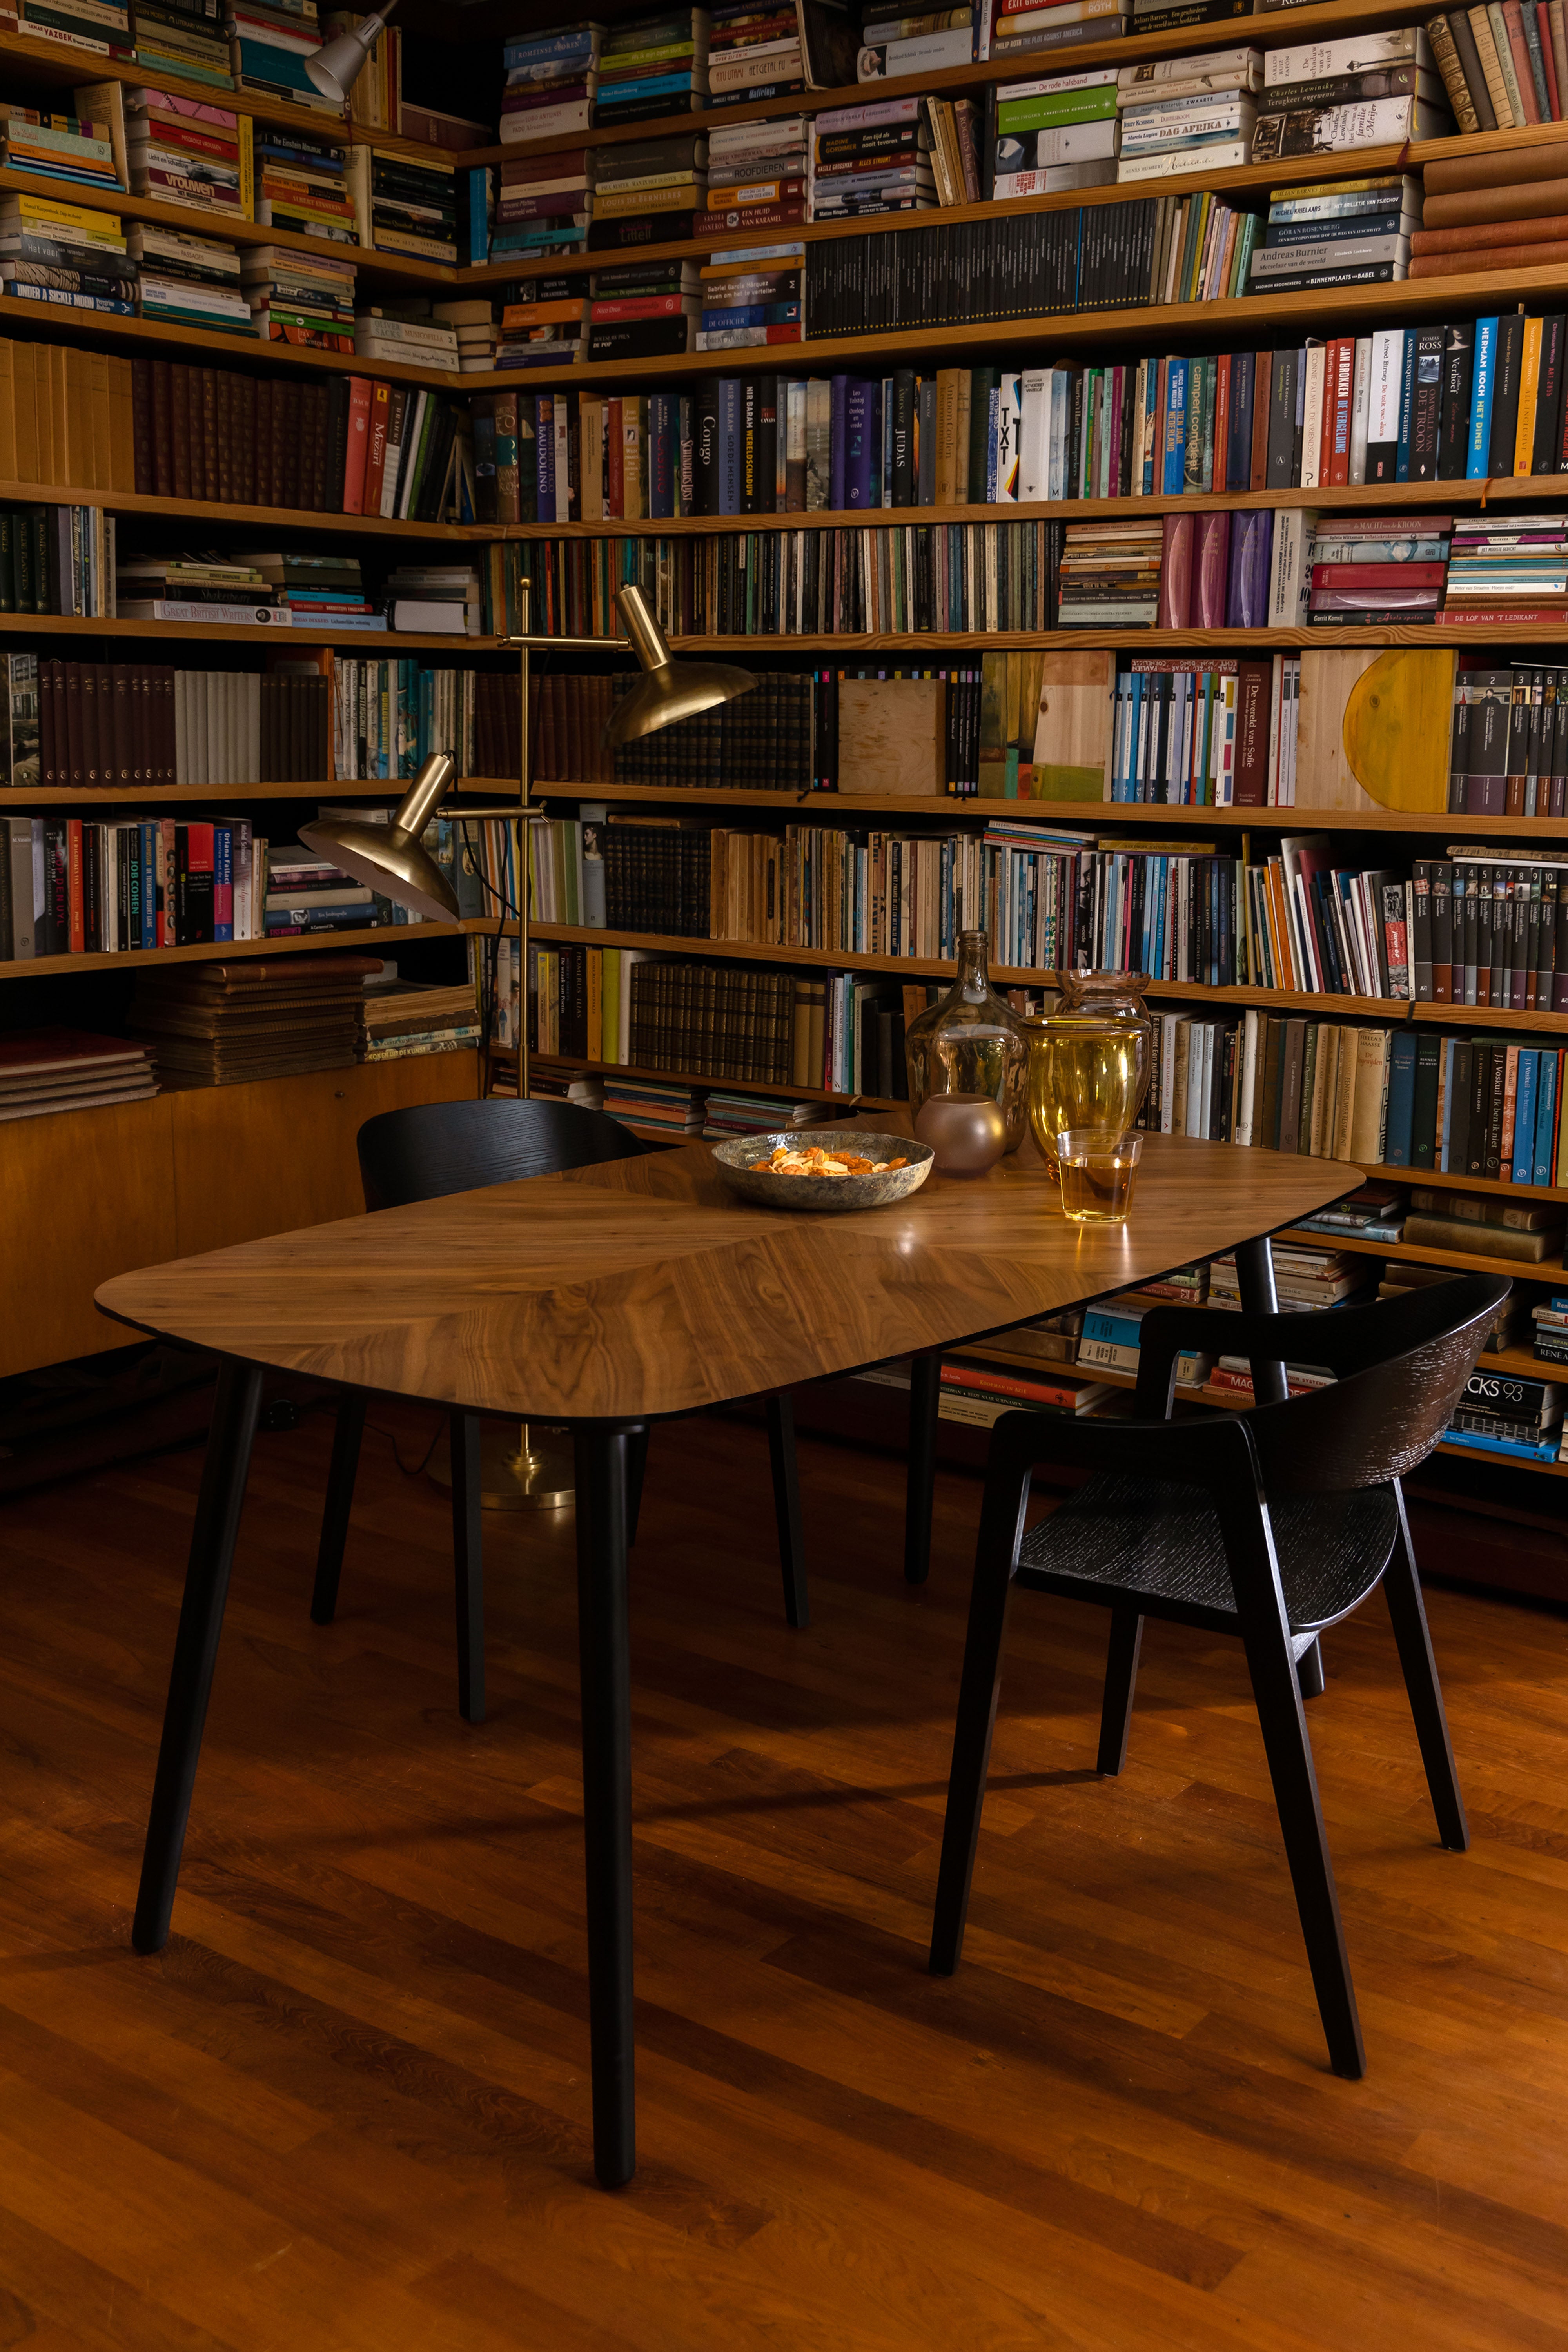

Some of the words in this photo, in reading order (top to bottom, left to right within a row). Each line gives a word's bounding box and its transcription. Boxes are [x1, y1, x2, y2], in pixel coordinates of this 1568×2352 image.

[44, 29, 72, 42] YAZBEK
[995, 41, 1009, 50] PHILIP
[1011, 40, 1022, 48] ROTH
[1032, 37, 1042, 45] PLOT
[1044, 33, 1062, 42] AGAINST
[1063, 27, 1083, 38] AMERICA
[1049, 81, 1061, 89] rode
[1062, 77, 1087, 87] halsband
[1299, 84, 1334, 94] Lewinsky
[1267, 97, 1301, 107] Terugkeer
[1302, 91, 1335, 102] ongewenst
[1357, 107, 1365, 137] familie
[1368, 104, 1377, 137] Meijer
[1159, 129, 1180, 138] DAG
[1181, 121, 1221, 134] AFRIKA
[282, 138, 301, 149] Einstein
[302, 142, 321, 154] Almanac
[826, 144, 857, 153] GORDIMER
[877, 138, 897, 146] tevoren
[148, 153, 158, 162] Licht
[168, 158, 189, 170] schaduw
[735, 163, 784, 178] ROOFDIEREN
[166, 174, 215, 196] vrouwen
[602, 198, 624, 207] LOUIS
[639, 191, 681, 203] BERNIÈRES
[1294, 205, 1321, 214] KRIELAARS
[1344, 200, 1365, 209] BRILLETJE
[704, 214, 724, 222] SANDRA
[742, 218, 753, 226] VAN
[753, 215, 782, 225] KARAMEL
[699, 222, 724, 232] CISNEROS
[28, 244, 40, 253] Het
[42, 245, 58, 257] veer
[1260, 250, 1294, 261] Andreas
[1296, 247, 1328, 258] Burnier
[1310, 274, 1351, 284] BINNENPLAATS
[17, 284, 40, 297] UNDER
[42, 288, 47, 300] A
[49, 289, 72, 305] SICKLE
[74, 296, 94, 309] MOON
[375, 321, 400, 330] OLIVER
[717, 318, 745, 326] OFFICIER
[375, 328, 400, 338] SACKS
[1419, 341, 1442, 350] ROSS
[1479, 327, 1489, 368] HERMAN
[1339, 347, 1350, 362] JAN
[1338, 363, 1350, 398] BROKKEN
[1450, 357, 1460, 395] Verhoef
[1478, 371, 1488, 397] KOCH
[1191, 366, 1201, 415] campert
[1418, 389, 1428, 405] DE
[1337, 400, 1348, 413] DE
[1476, 400, 1485, 419] HET
[1000, 408, 1009, 465] TXT
[1167, 411, 1176, 452] NEDERLAND
[1335, 413, 1347, 454] VERGELDING
[1416, 408, 1427, 453] TROON
[1474, 422, 1485, 451] DINER
[373, 422, 385, 465] Mozart
[699, 416, 716, 466] Congo
[895, 428, 906, 468] JUDAS
[1189, 417, 1199, 472] compleet
[539, 426, 547, 494] BAUDOLINO
[163, 604, 189, 618] GREAT
[190, 606, 219, 620] BRITISH
[221, 608, 253, 621] WRITERS
[1251, 686, 1259, 696] De
[1249, 698, 1257, 727] wereld
[1246, 746, 1255, 768] Sofie
[131, 860, 139, 878] JOB
[131, 879, 139, 915] COHEN
[1494, 1054, 1504, 1067] J.J.
[1494, 1068, 1503, 1096] Voskuil
[1494, 1098, 1501, 1107] Ik
[1540, 1348, 1562, 1359] RENÉ
[1303, 1378, 1327, 1387] SYSTEMS
[1503, 1383, 1523, 1402] 93
